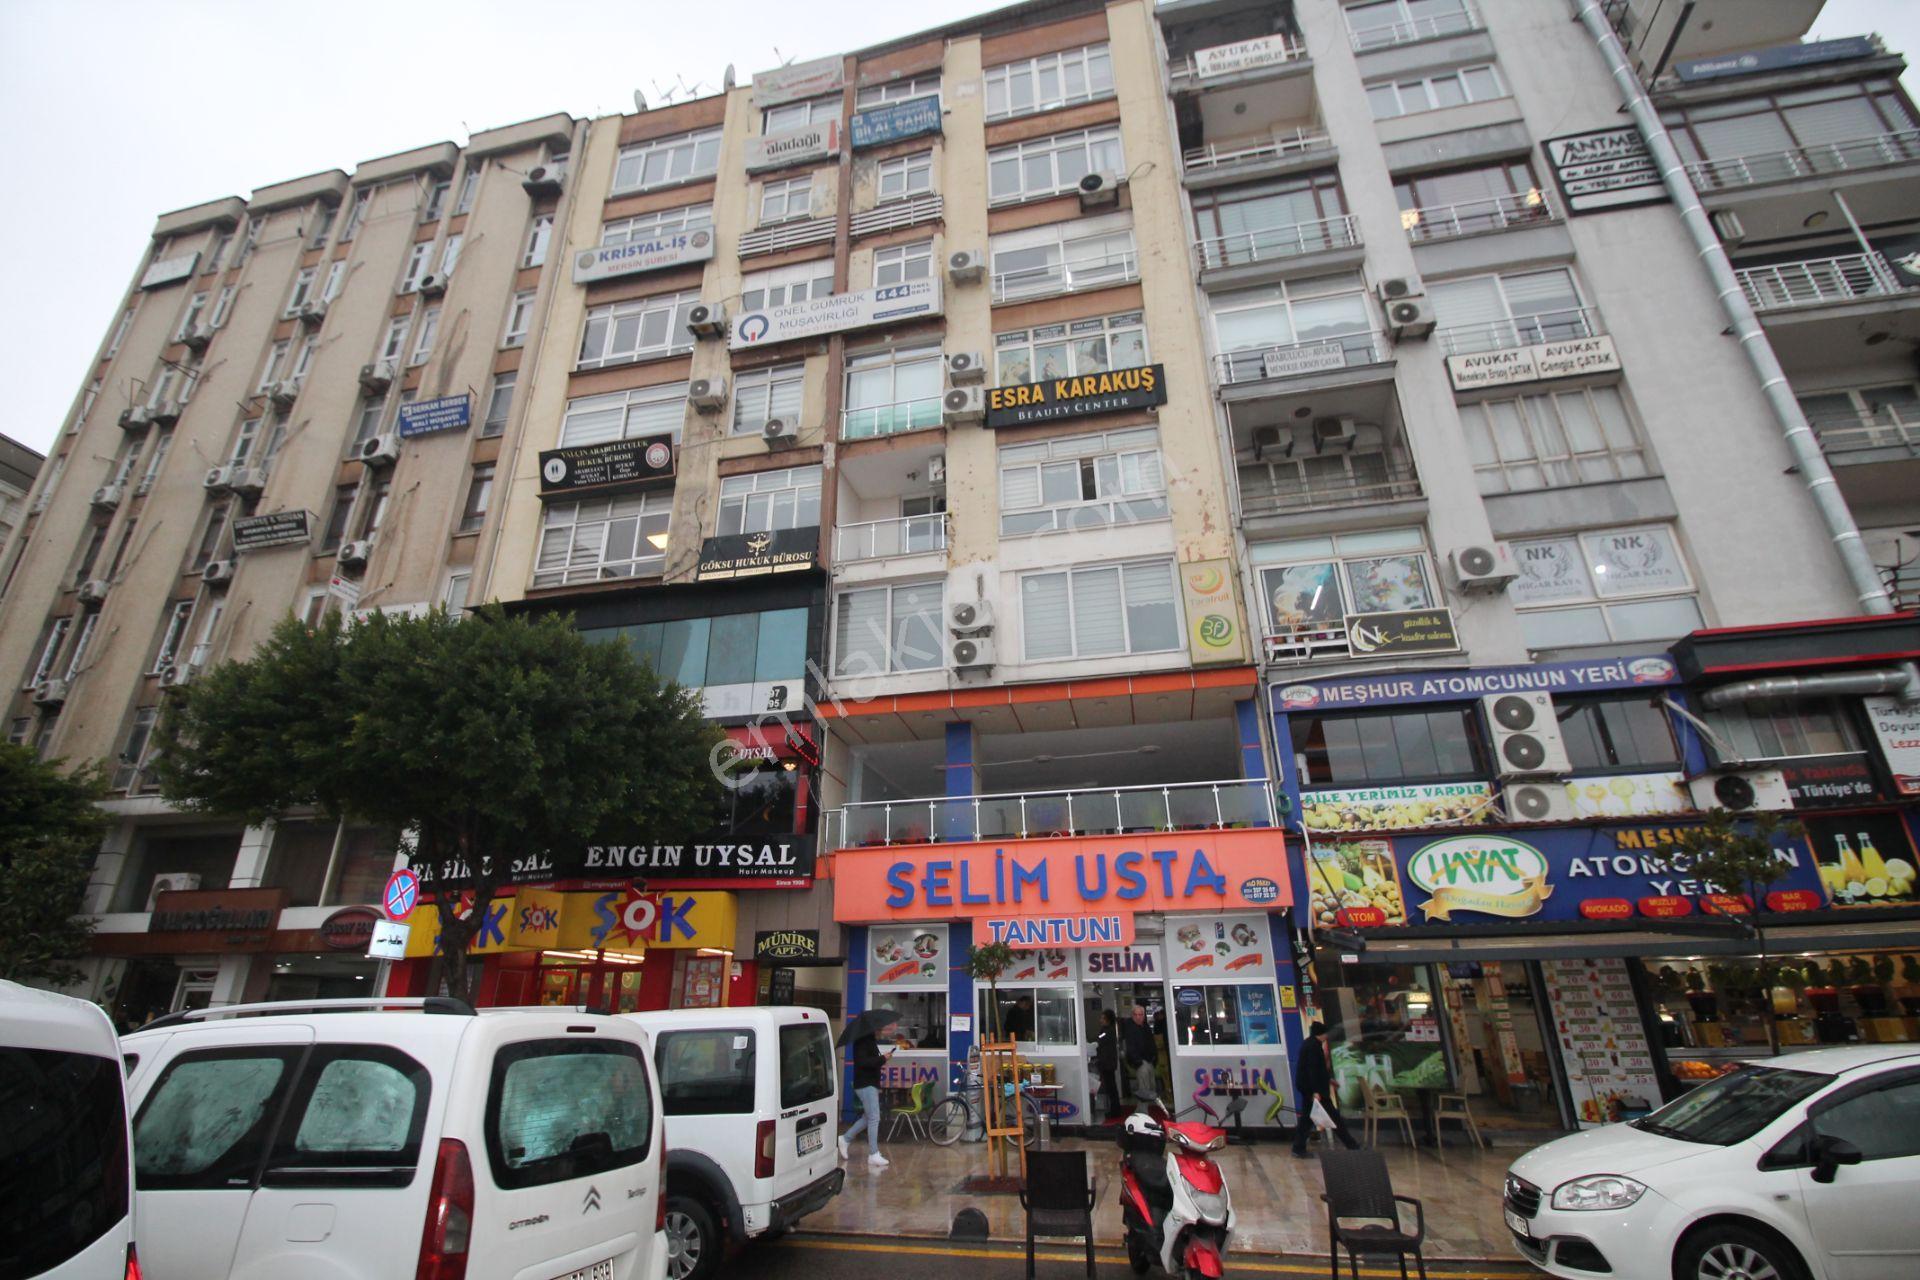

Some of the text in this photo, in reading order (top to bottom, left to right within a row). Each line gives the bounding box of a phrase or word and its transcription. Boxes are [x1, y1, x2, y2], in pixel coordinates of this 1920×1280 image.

[1207, 40, 1270, 62] AVUKAT
[597, 234, 688, 263] KRİSTAL-İŞ
[876, 285, 909, 300] 444
[1545, 341, 1602, 358] AVUKAT
[1464, 351, 1520, 369] AVUKAT
[1539, 352, 1613, 374] Cengiz ÇATAK
[991, 367, 1156, 410] ESRA KARAKUŞ
[1073, 396, 1130, 413] CENTER
[589, 440, 649, 456] ARABULUCULUK
[576, 451, 634, 468] HUKUK BÜROSU
[1612, 535, 1644, 551] NK
[700, 560, 735, 572] GÖKSU
[735, 555, 772, 568] HUKUK
[772, 550, 813, 564] BÜROSU
[1524, 546, 1556, 561] NK
[1322, 680, 1416, 703] MEŞHUR
[1422, 669, 1567, 696] ATOMCUNUN
[1570, 661, 1629, 684] YERİ
[739, 745, 775, 760] UYSAL
[1304, 784, 1485, 805] AİLE YERİMİZ VARDIR
[1801, 781, 1873, 799] Türkiye'de
[481, 849, 554, 877] USAL
[584, 840, 797, 868] ENGİN UYSAL
[738, 867, 795, 876] Hair Makeup
[1427, 847, 1520, 885] HAYAT
[775, 879, 792, 887] Since
[886, 848, 1227, 908] SELİM USTA
[1649, 878, 1728, 897] YER
[1781, 893, 1801, 901] NAR
[1347, 912, 1376, 923] ATOM
[1584, 903, 1629, 914] AVOKADO
[519, 902, 559, 934] ŞOK
[590, 891, 698, 948] ŞOK
[758, 930, 816, 956] MÜNİRE
[774, 945, 798, 956] APT.
[1088, 946, 1155, 974] SELİM
